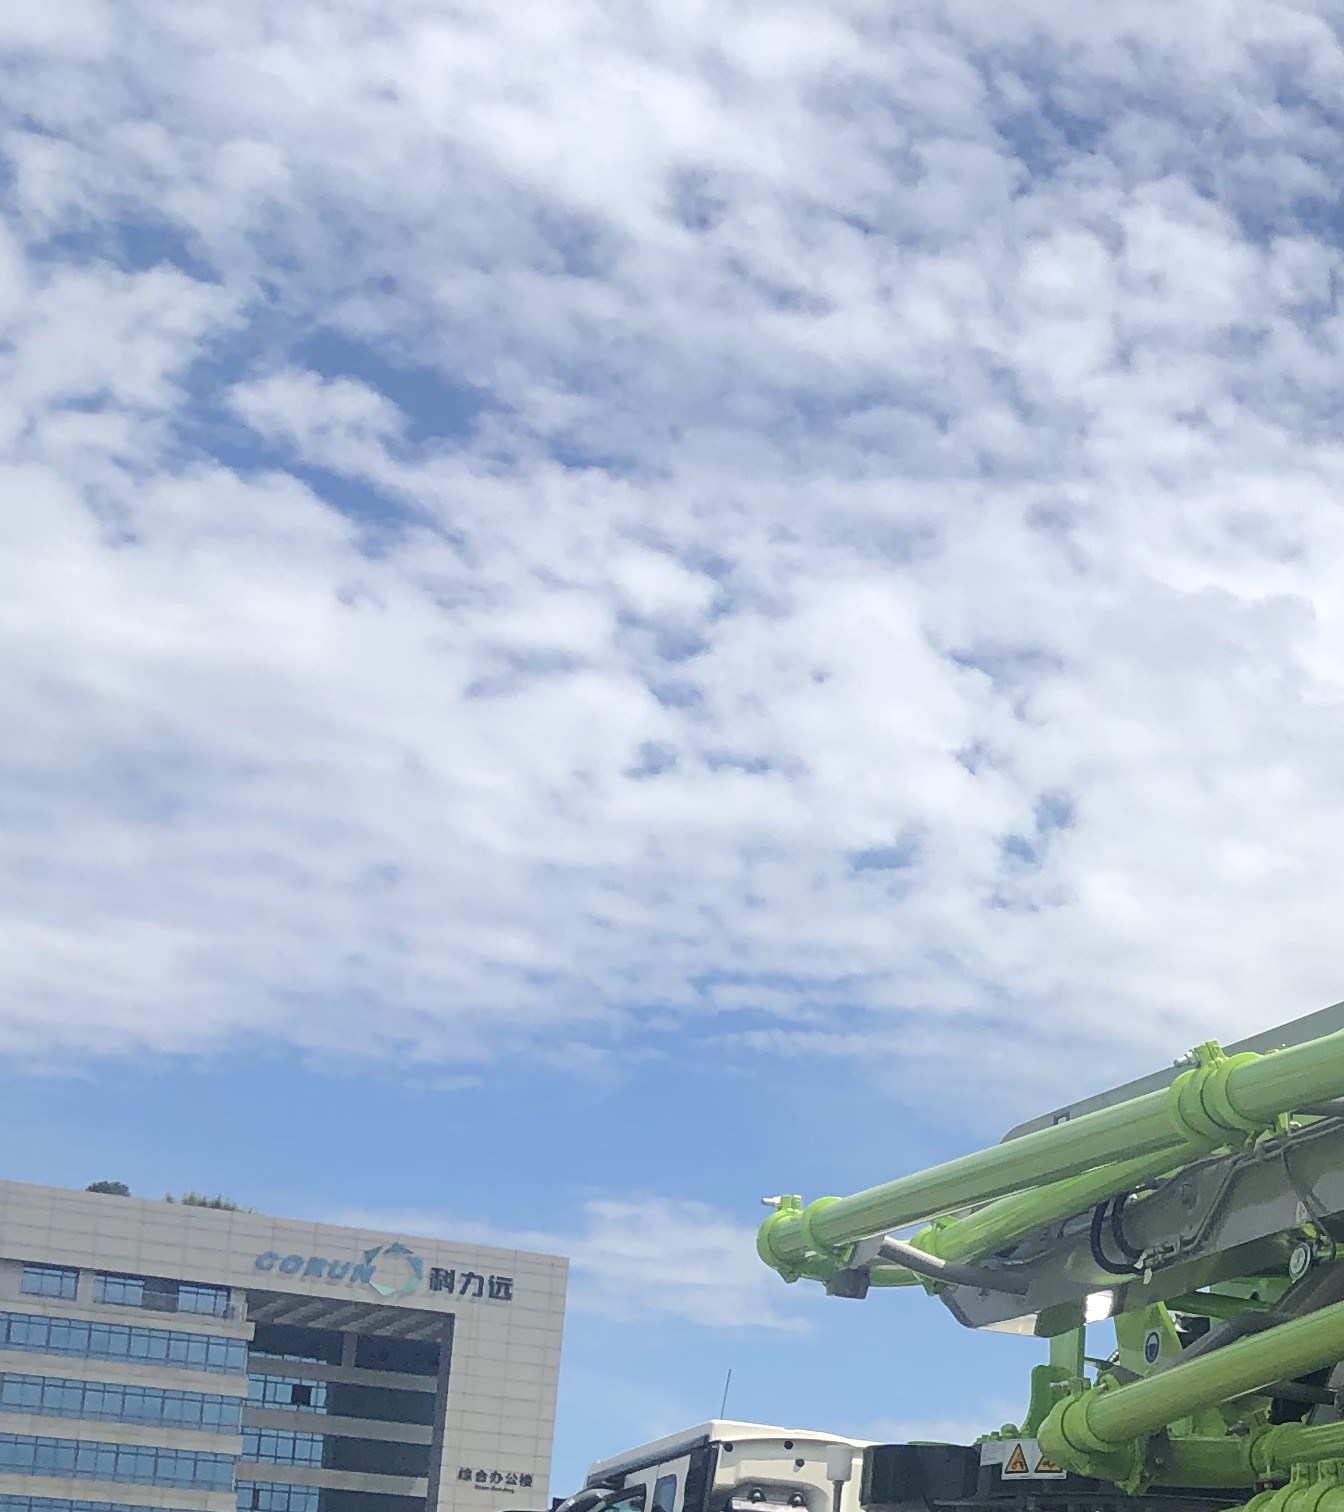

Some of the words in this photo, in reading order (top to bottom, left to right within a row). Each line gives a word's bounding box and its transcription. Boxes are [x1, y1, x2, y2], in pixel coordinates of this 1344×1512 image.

[255, 1250, 376, 1284] CORUN
[428, 1266, 514, 1301] 科力远
